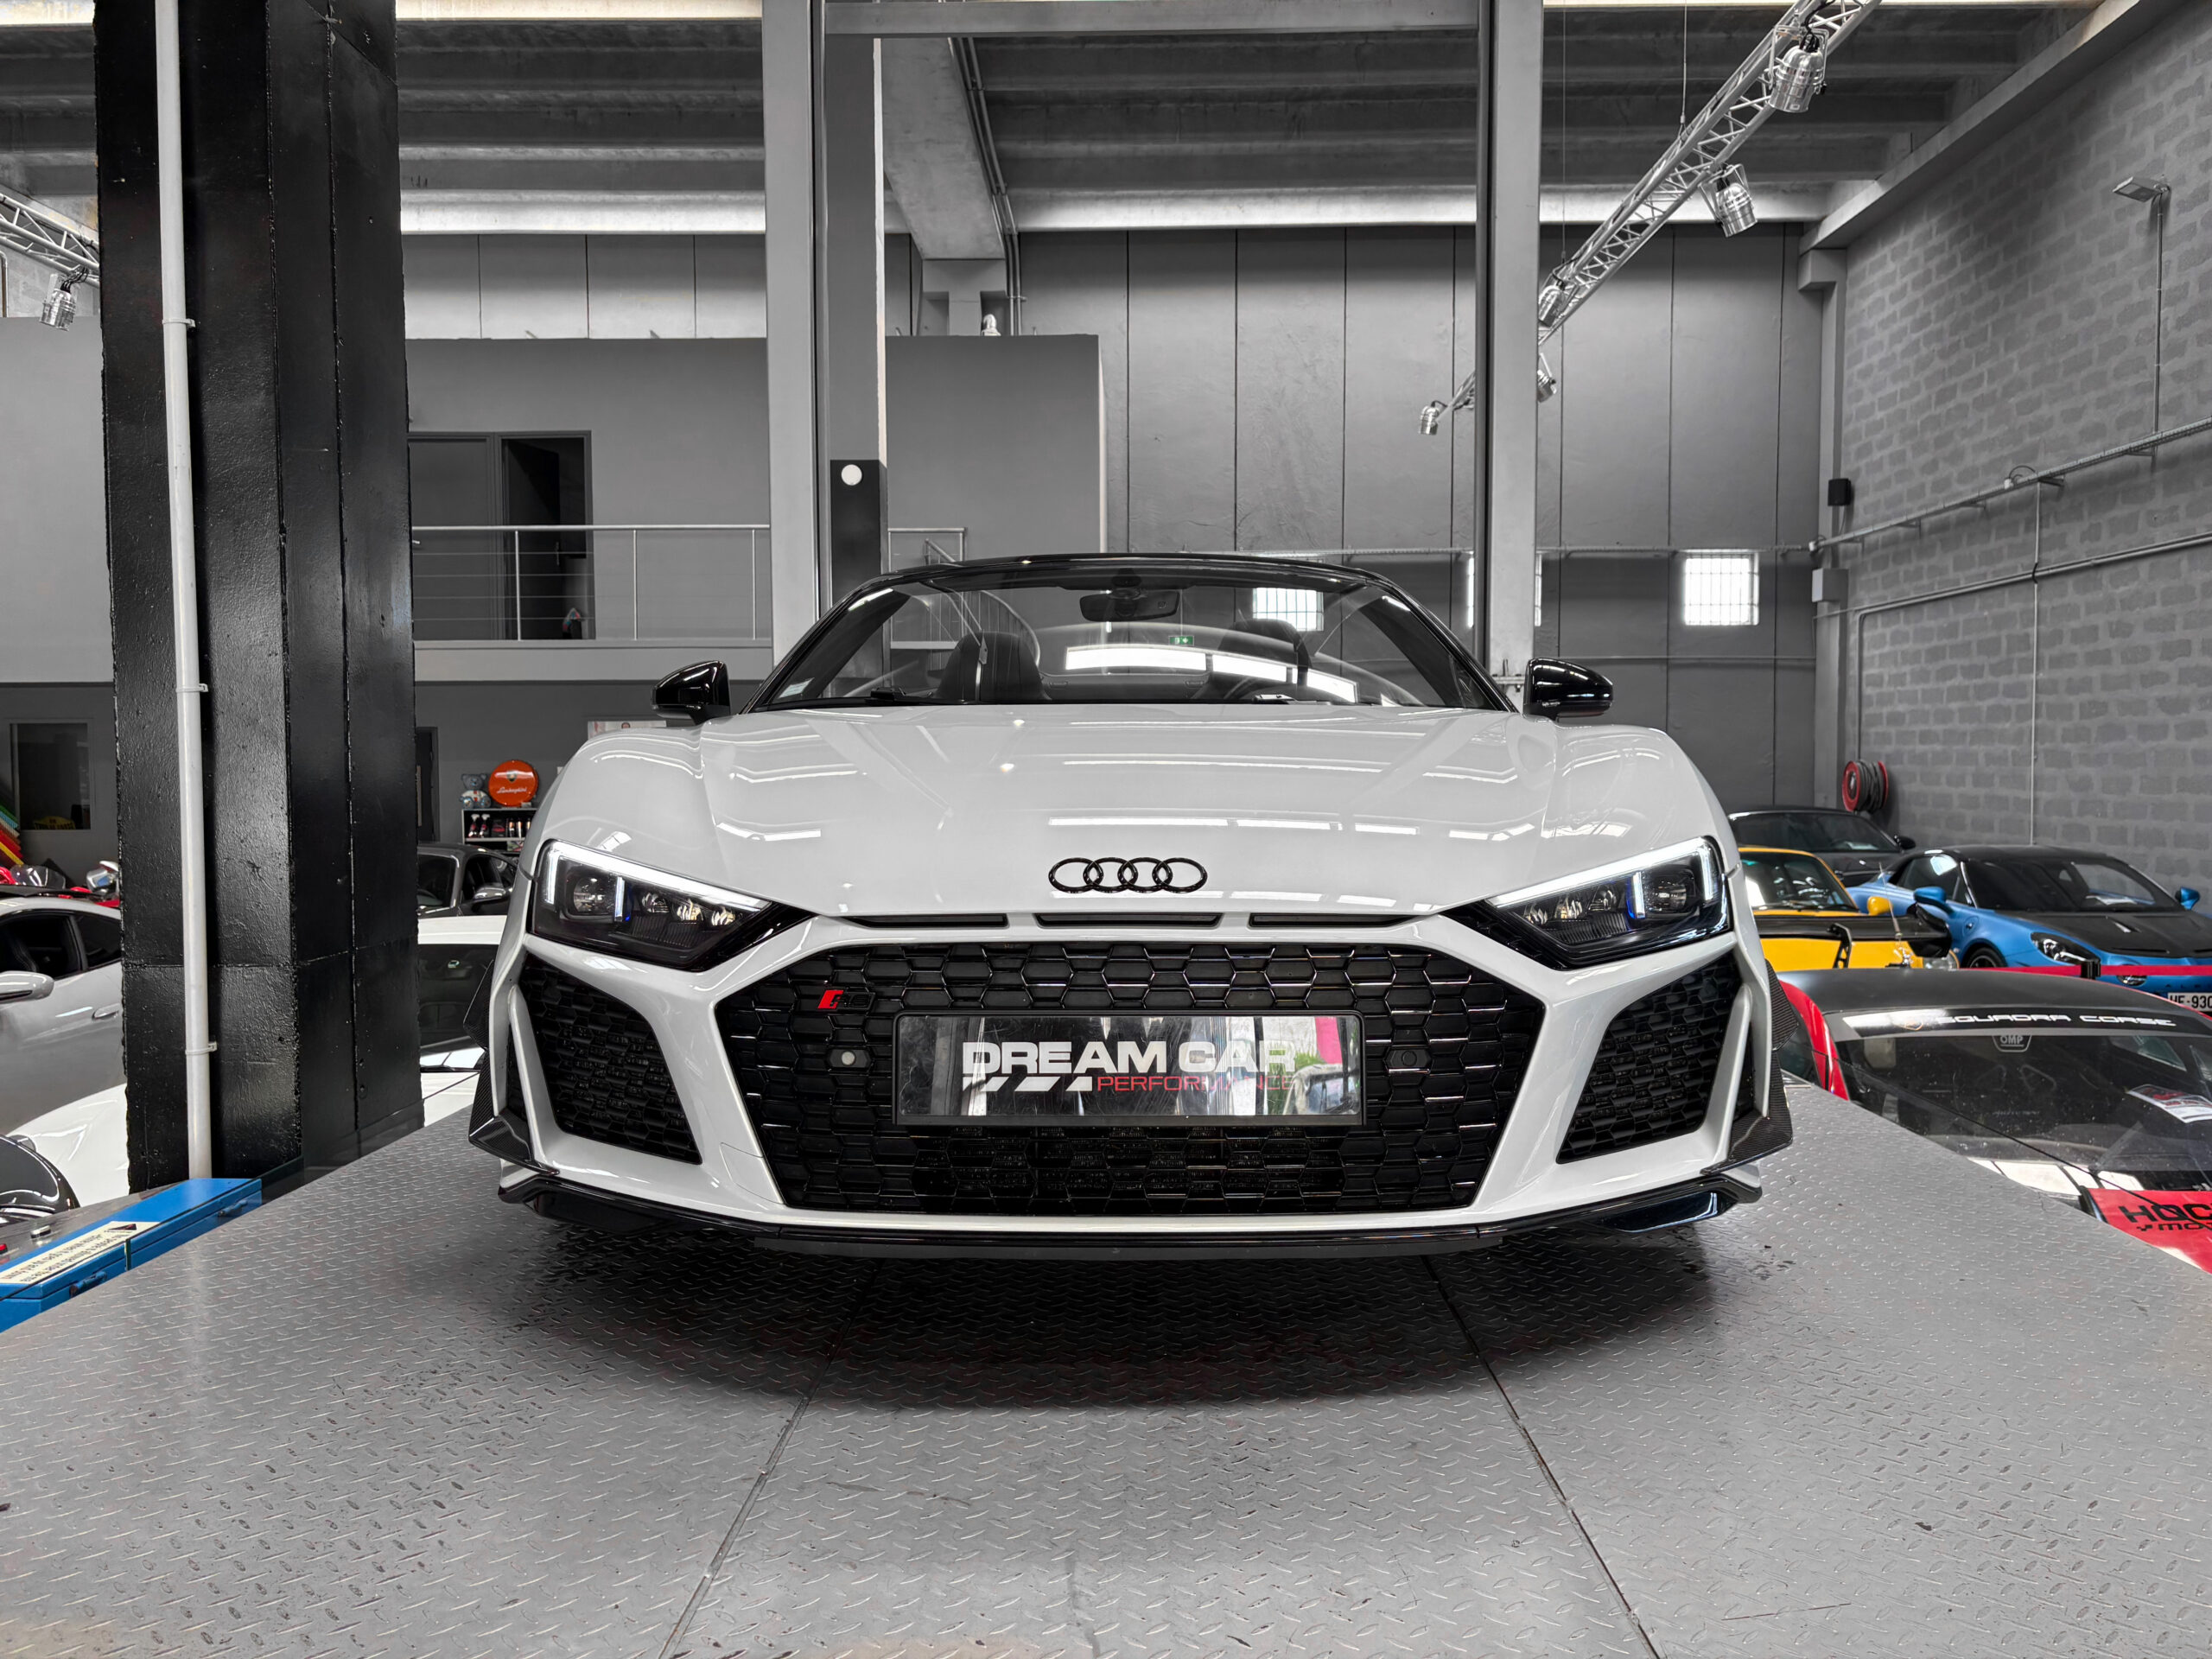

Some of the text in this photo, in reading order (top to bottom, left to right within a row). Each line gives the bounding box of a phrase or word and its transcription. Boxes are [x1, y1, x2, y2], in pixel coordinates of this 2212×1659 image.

[1936, 1014, 2177, 1027] SQUADRA CORSE
[1999, 1036, 2024, 1045] OMP
[963, 1040, 1295, 1073] DREAM CAR
[2118, 1203, 2212, 1223] HOC
